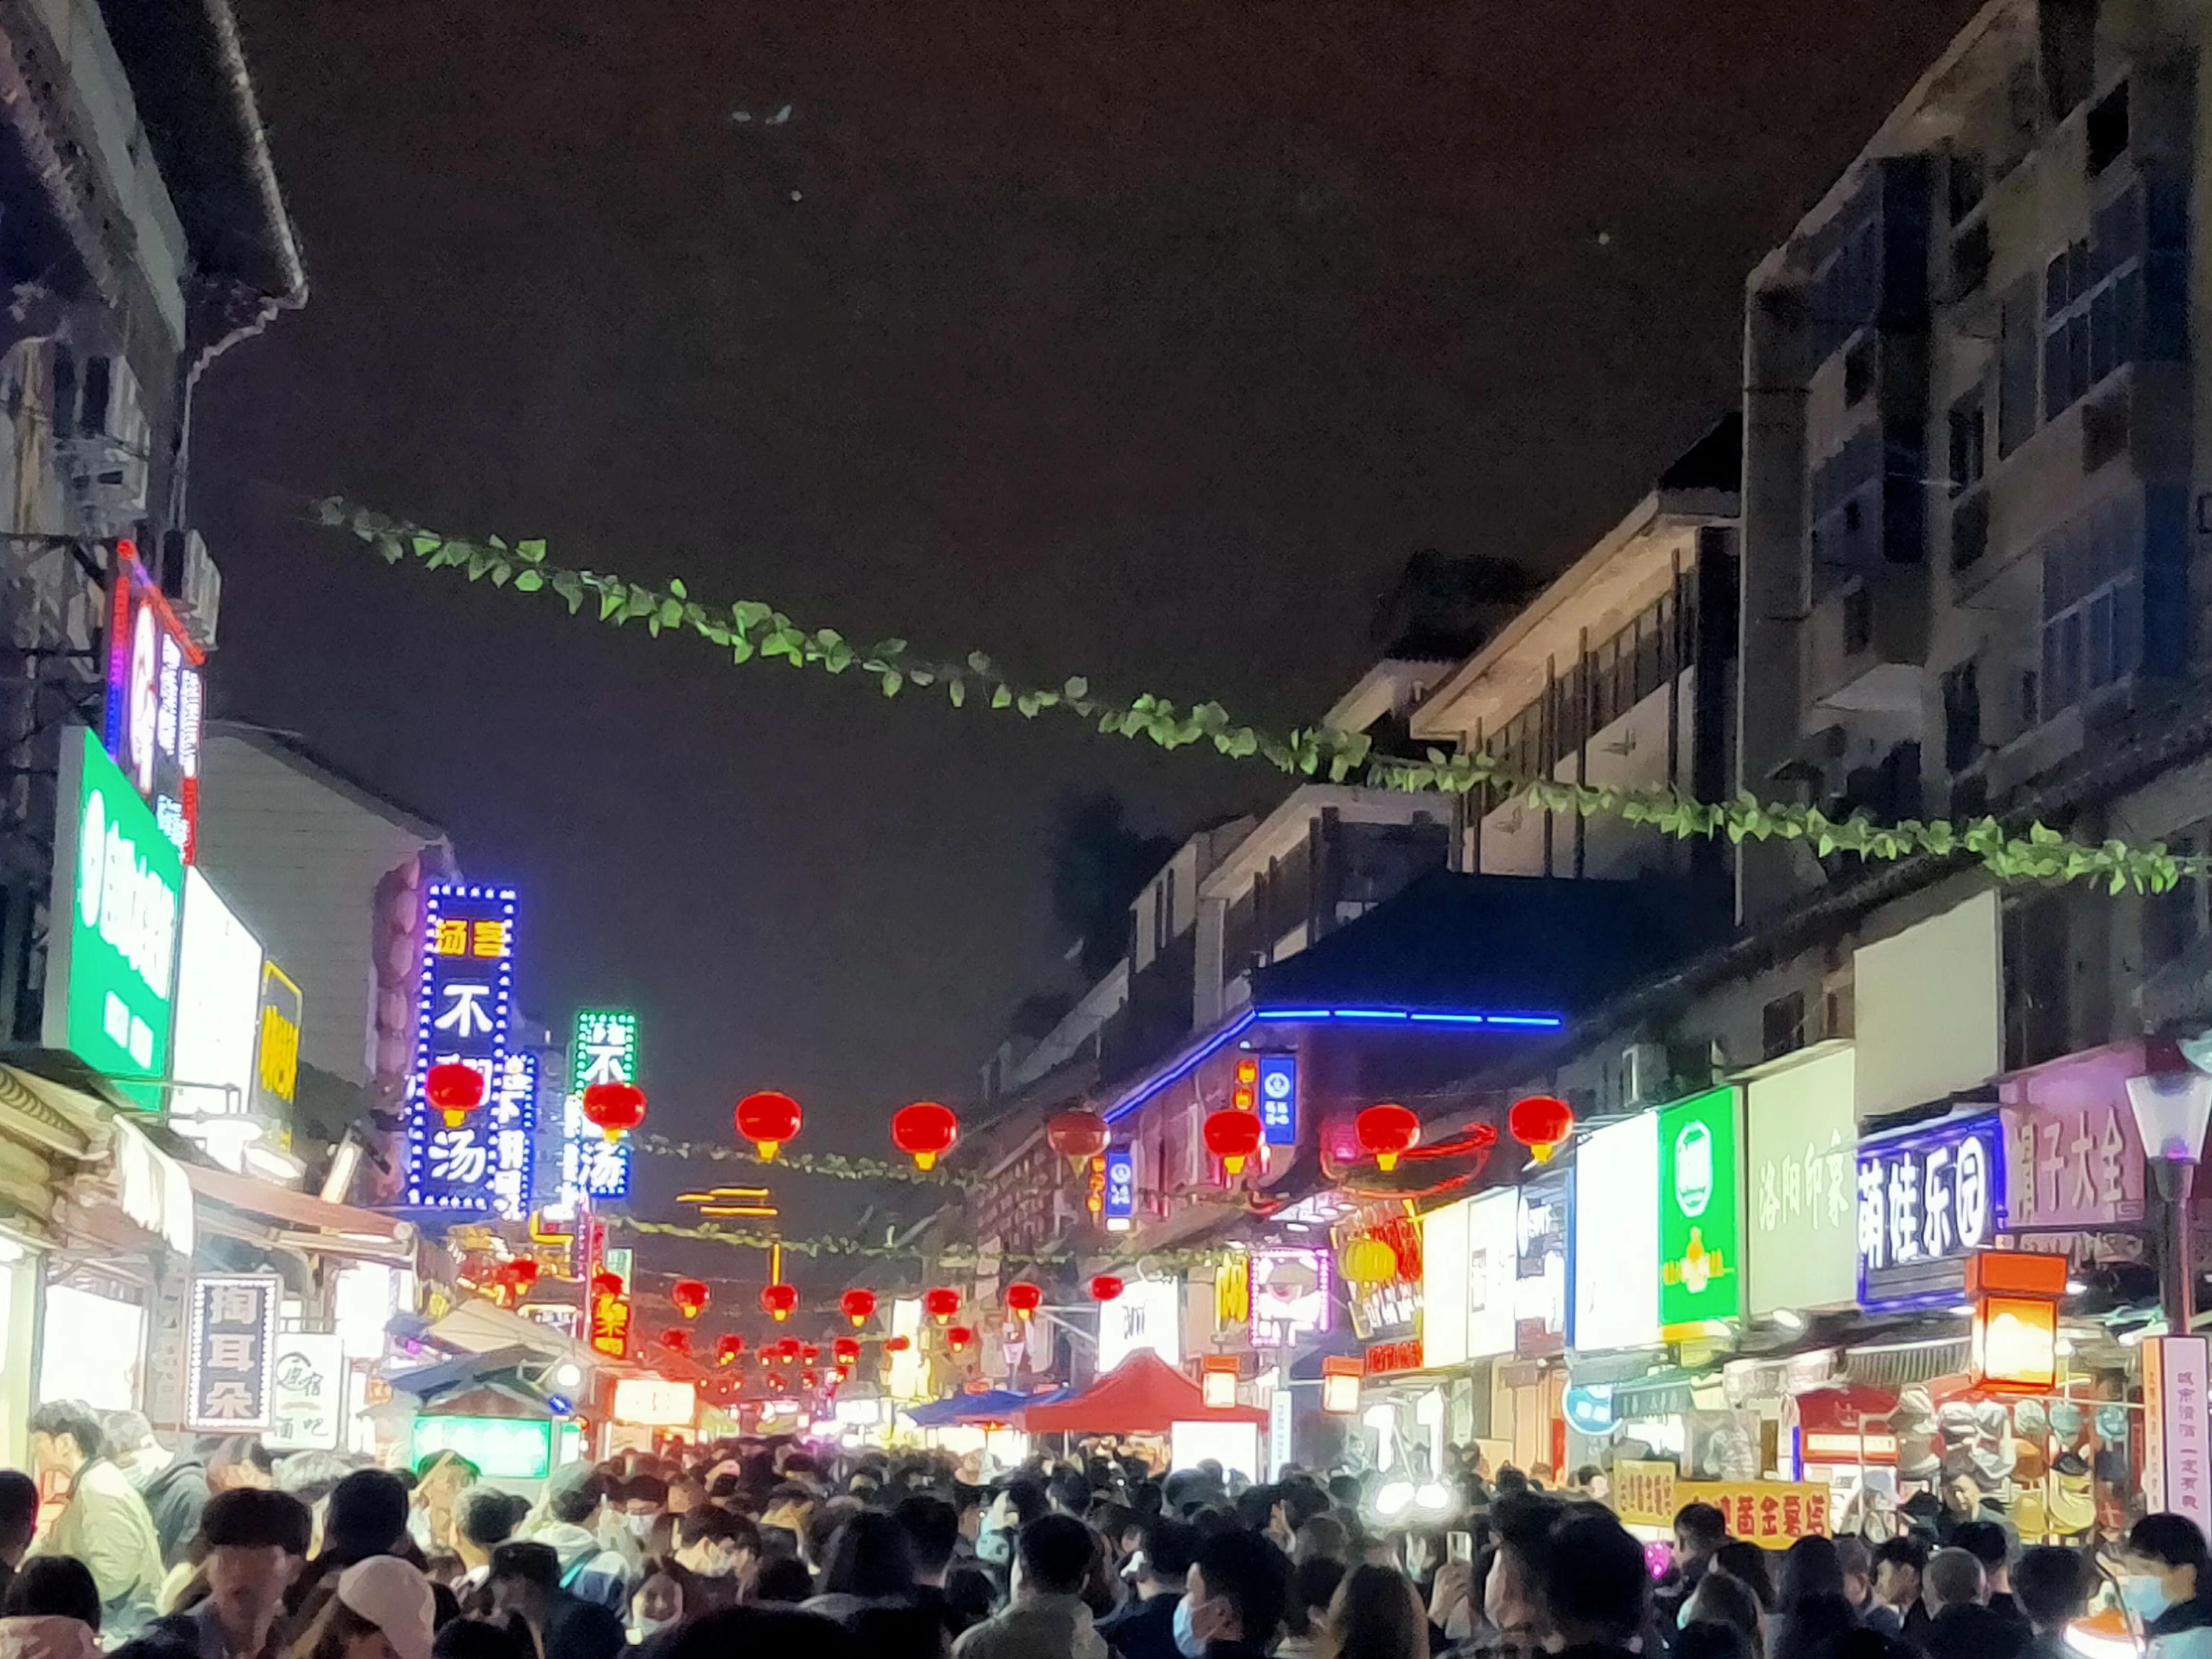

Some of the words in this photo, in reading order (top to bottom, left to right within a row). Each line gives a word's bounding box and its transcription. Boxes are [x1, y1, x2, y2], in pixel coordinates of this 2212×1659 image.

[428, 985, 493, 1183] 不汤
[1758, 1128, 1849, 1230] 洛阳印象
[1858, 1136, 1986, 1269] 萌娃乐园
[204, 1286, 258, 1419] 掏耳朵
